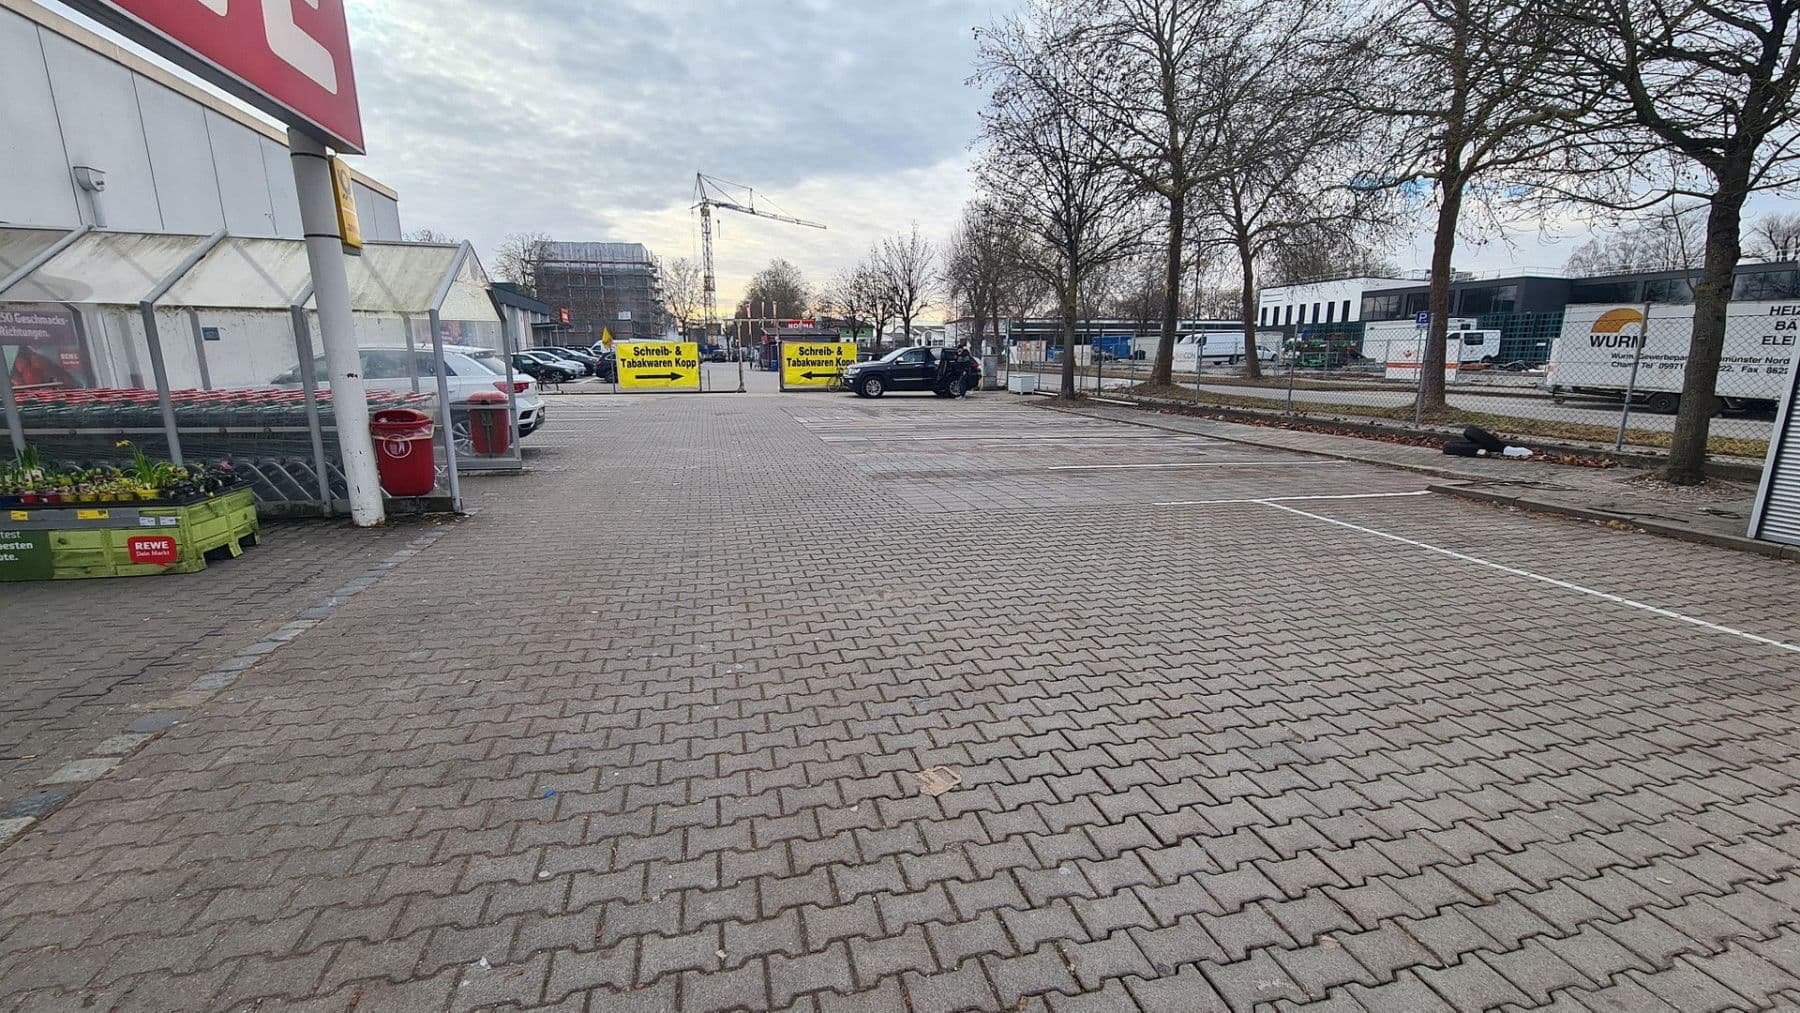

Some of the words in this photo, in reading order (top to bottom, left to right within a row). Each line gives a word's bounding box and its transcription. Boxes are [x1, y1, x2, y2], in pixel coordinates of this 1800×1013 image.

[1418, 313, 1428, 323] P
[1590, 335, 1647, 349] WURM
[633, 346, 673, 357] Schreib-
[675, 346, 682, 357] &
[798, 346, 835, 356] Schreib-
[836, 346, 843, 356] &
[786, 358, 834, 368] Tabakwaren
[1639, 354, 1690, 362] Gewerbepar
[1764, 357, 1791, 365] Nord
[620, 358, 672, 369] Tabakwaren
[674, 357, 697, 370] Kopp
[134, 542, 170, 550] REWE
